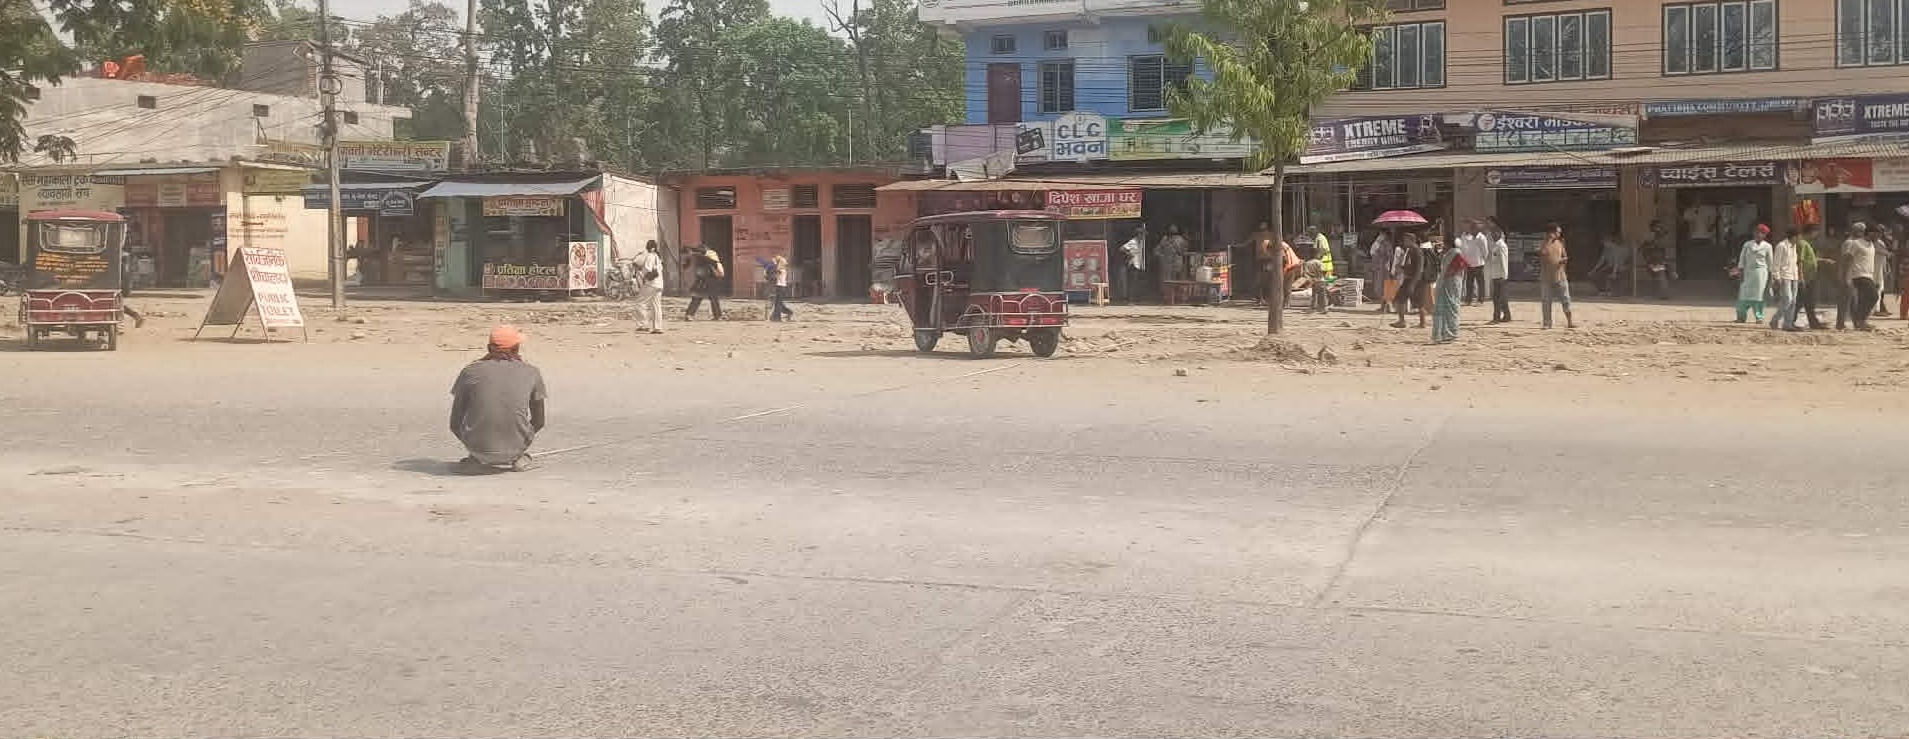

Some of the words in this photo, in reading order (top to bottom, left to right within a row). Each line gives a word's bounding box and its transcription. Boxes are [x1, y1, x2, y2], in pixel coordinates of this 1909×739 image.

[1863, 103, 1909, 119] XTREME
[1343, 119, 1407, 139] XTREME
[1056, 140, 1104, 156] भवन
[257, 292, 293, 304] PUBLIC
